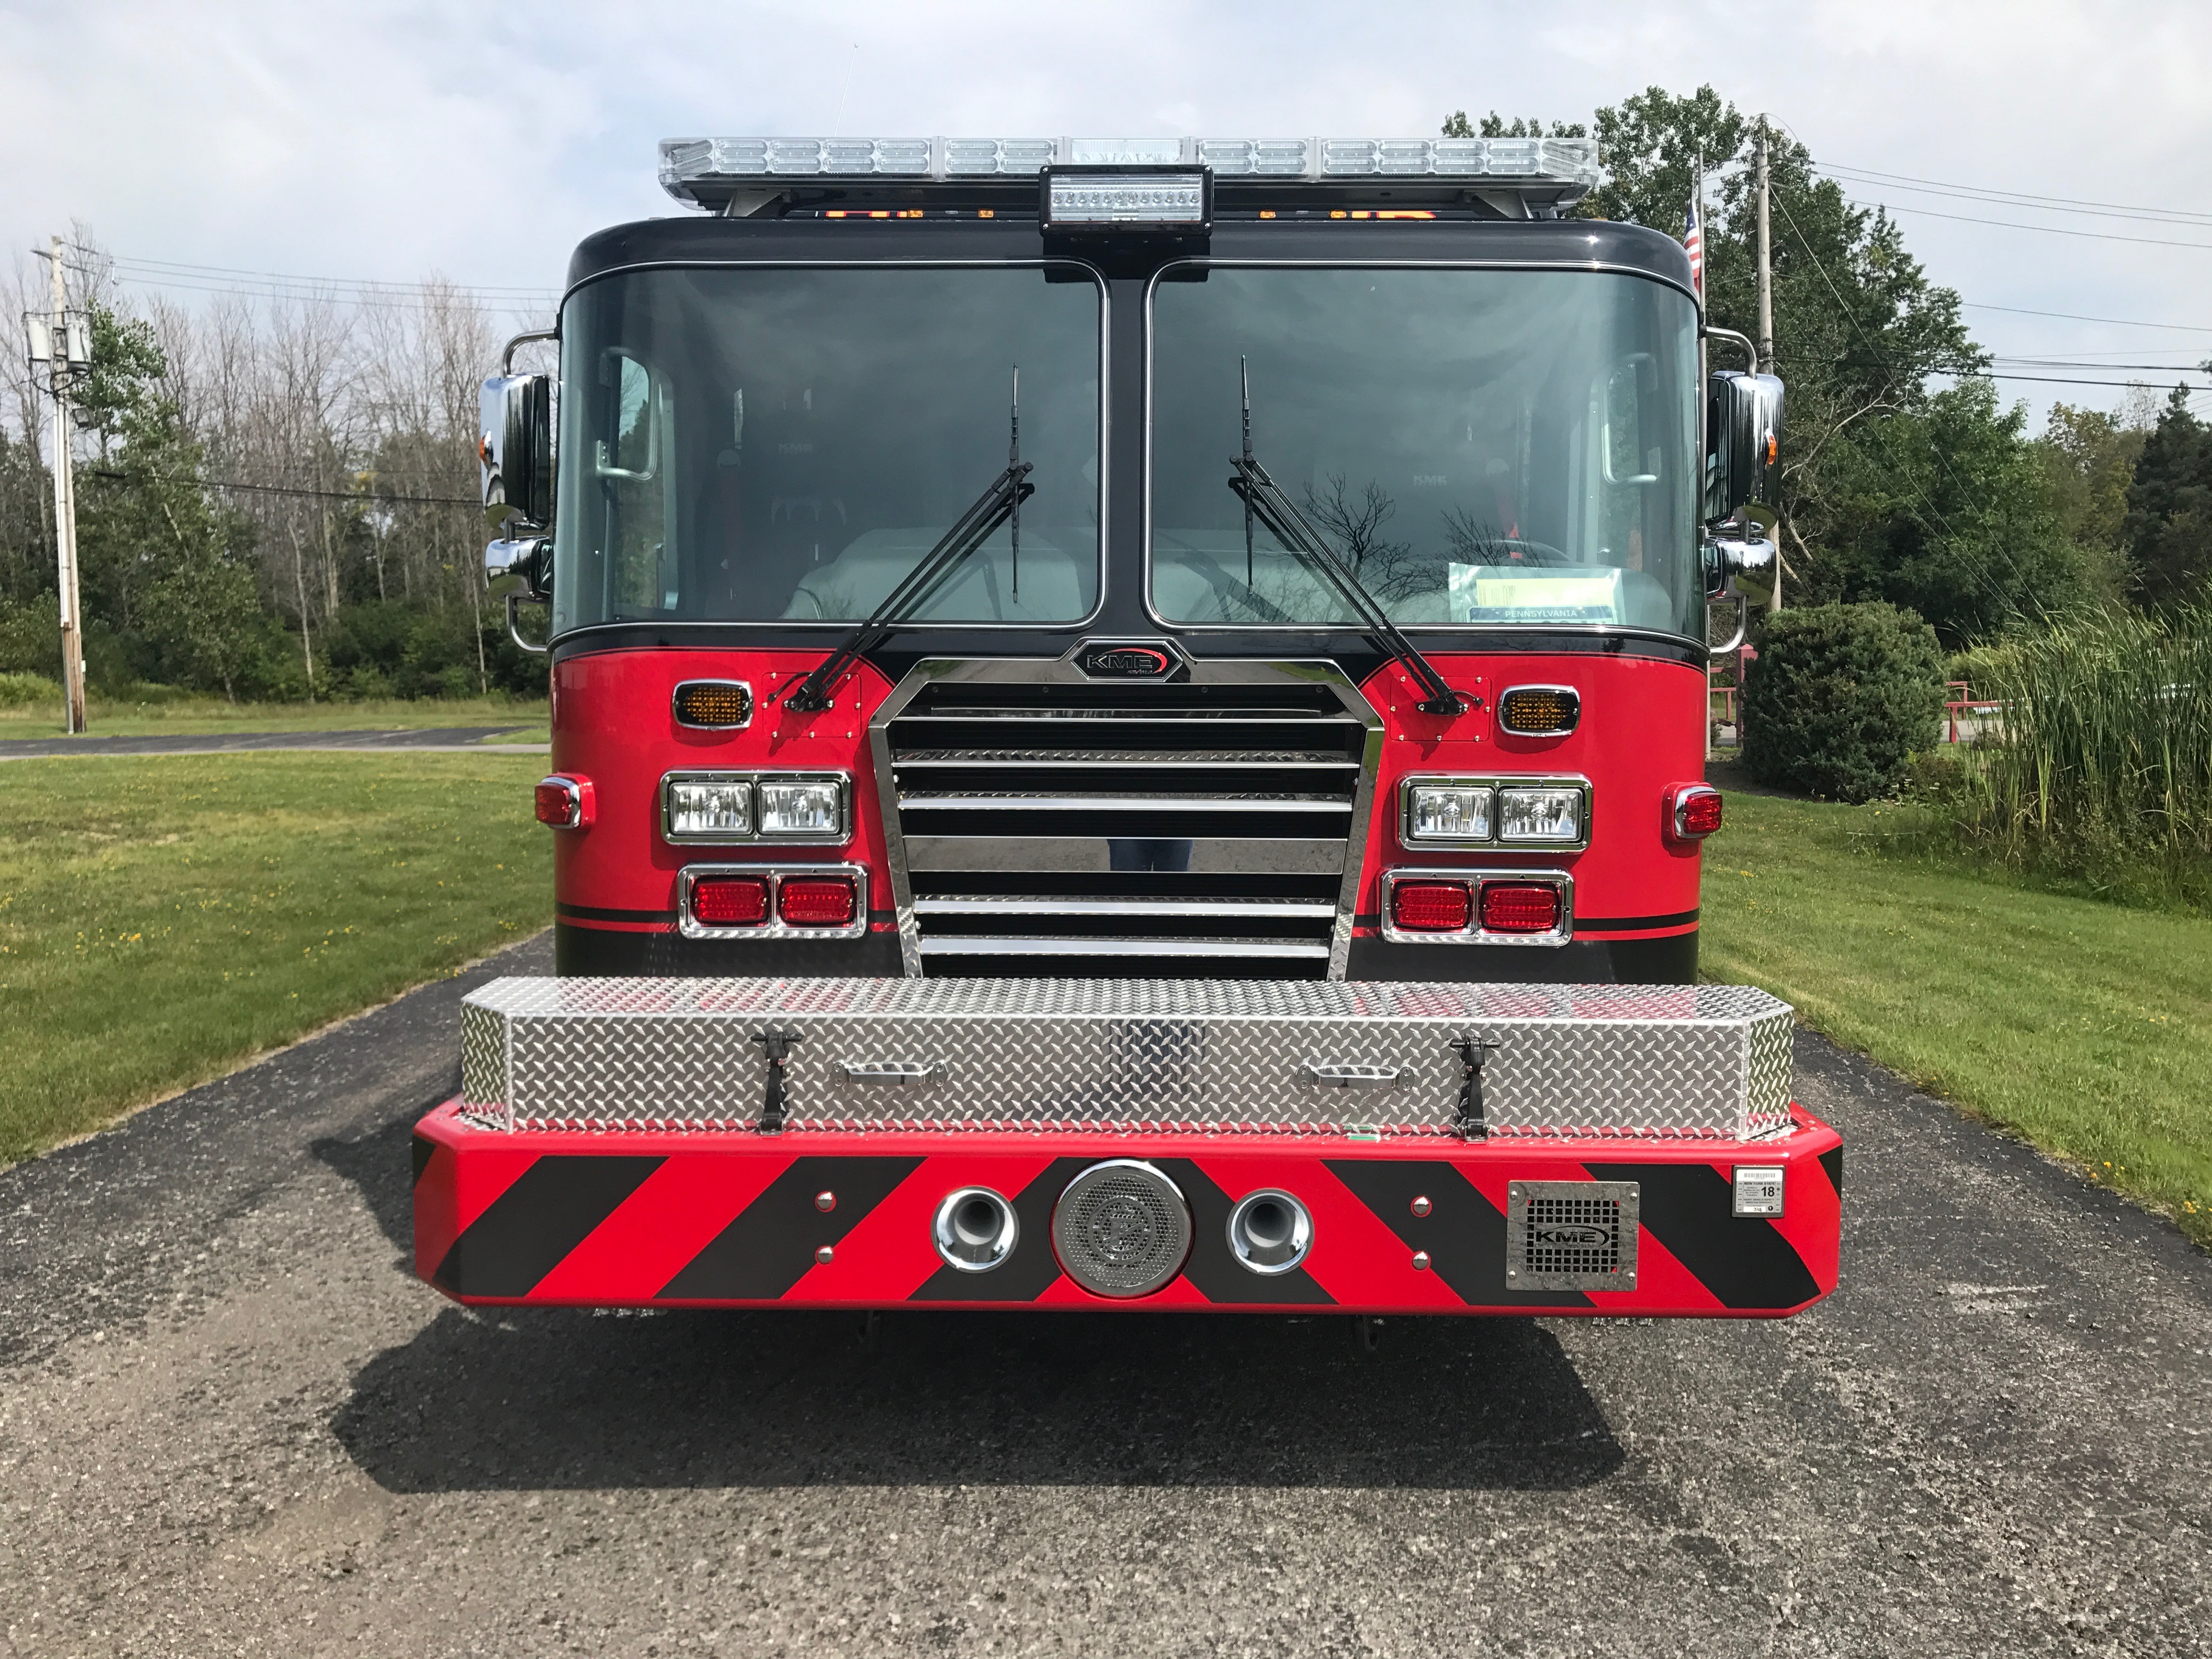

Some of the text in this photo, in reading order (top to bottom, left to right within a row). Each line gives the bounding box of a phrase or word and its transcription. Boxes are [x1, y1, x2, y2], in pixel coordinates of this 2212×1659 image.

[1413, 475, 1447, 486] KME
[1505, 610, 1577, 618] PENNSYLVANIA
[1087, 655, 1153, 669] KME
[1762, 1186, 1775, 1197] 18
[1536, 1232, 1596, 1243] KME
